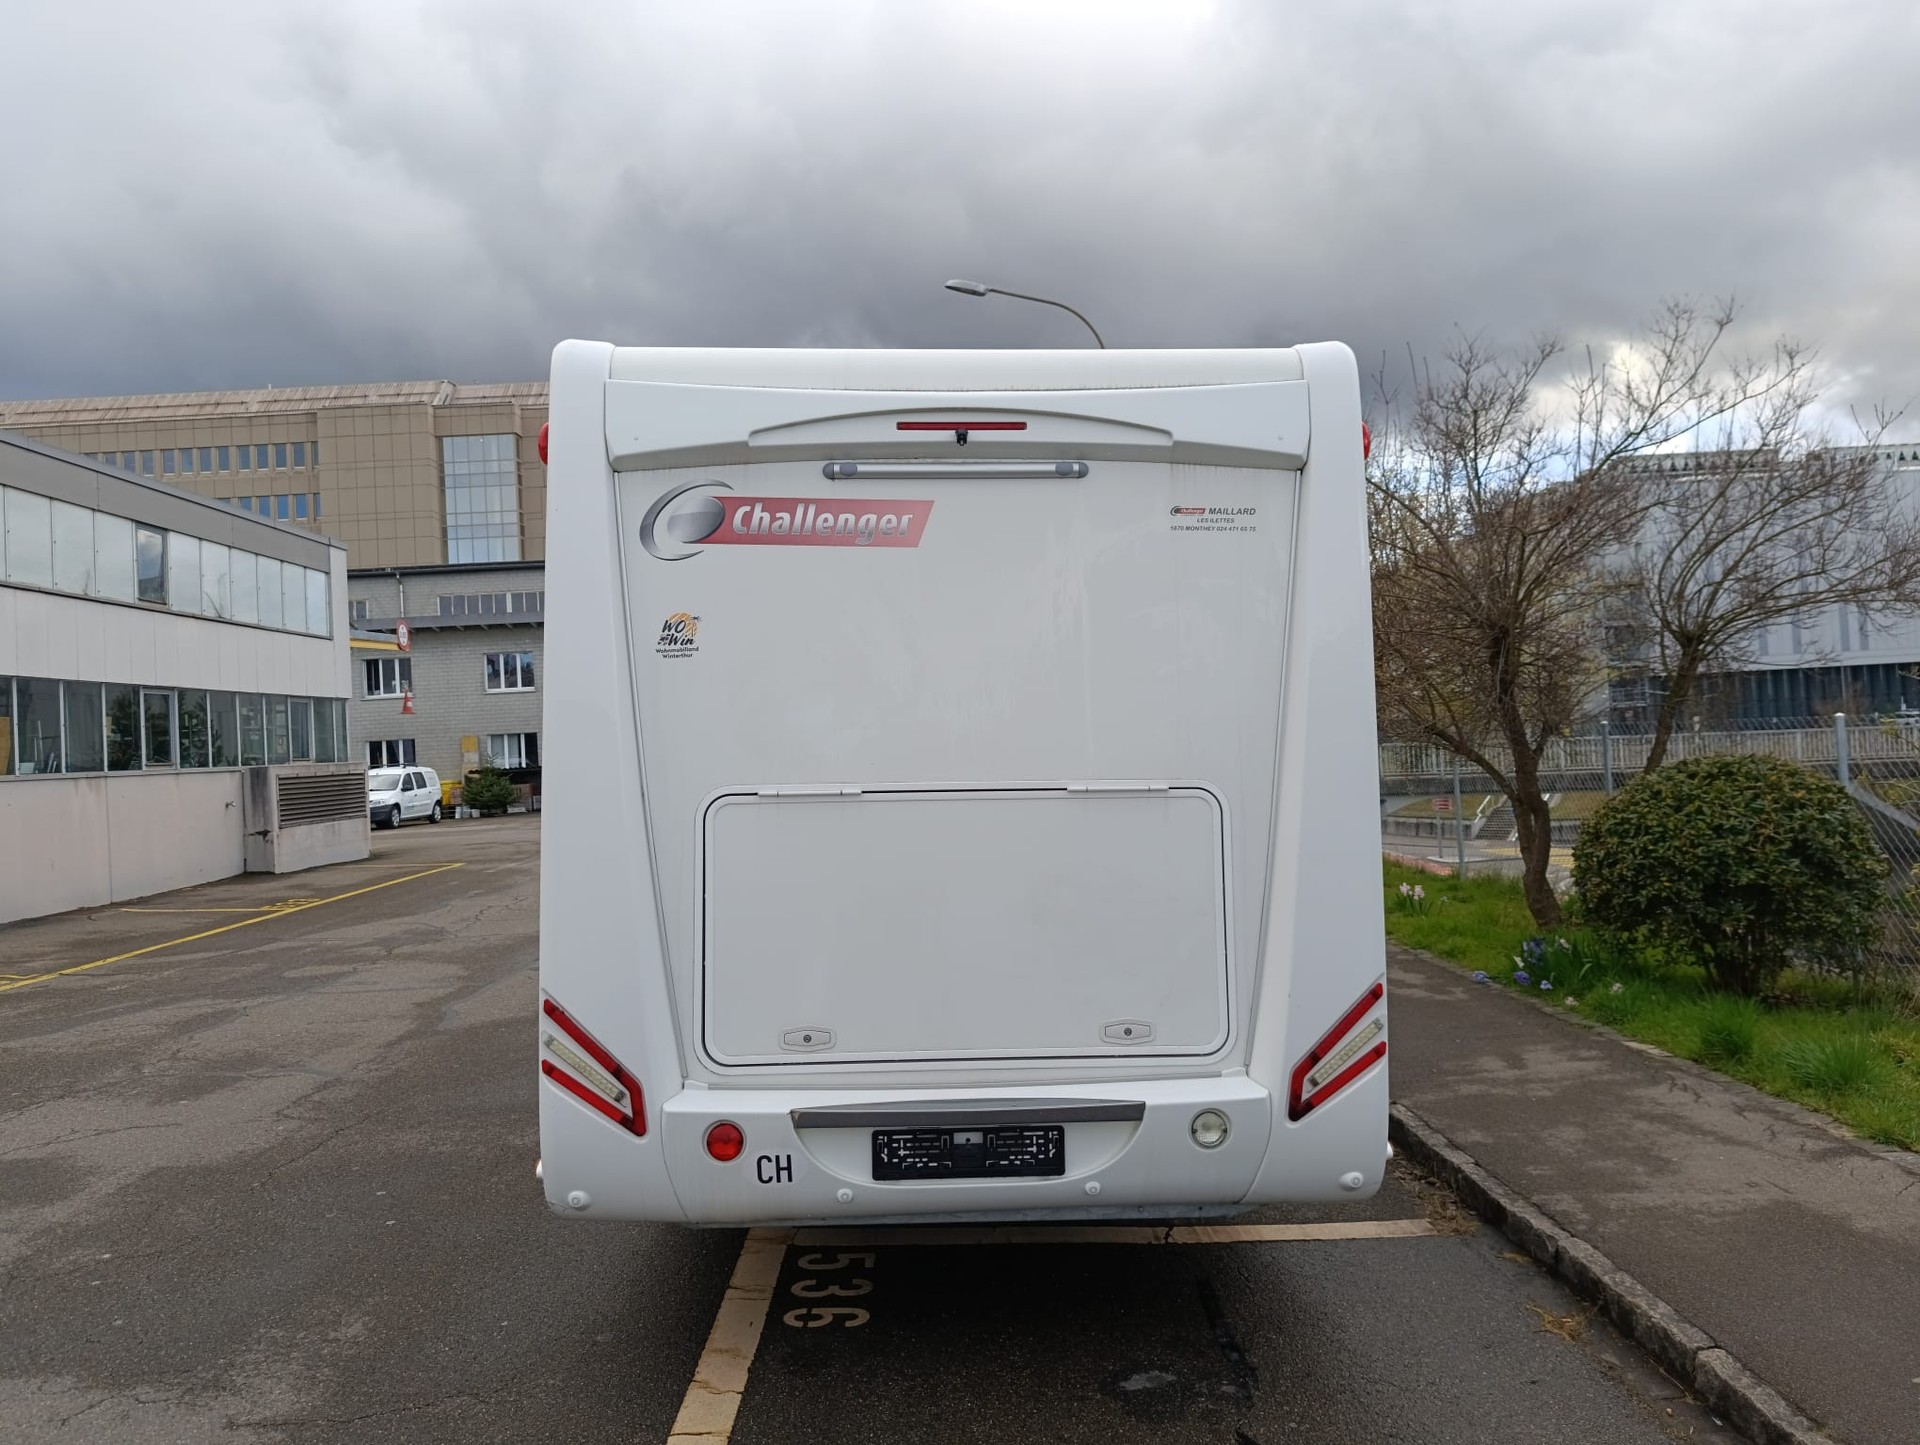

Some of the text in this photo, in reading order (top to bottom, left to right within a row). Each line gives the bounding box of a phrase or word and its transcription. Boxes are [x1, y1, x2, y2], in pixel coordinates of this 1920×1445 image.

[1208, 507, 1257, 516] MAILLARD
[732, 502, 915, 545] Challenger
[662, 620, 686, 633] WO
[667, 633, 695, 646] Win
[756, 1154, 793, 1184] CH
[783, 1252, 878, 1328] 536
